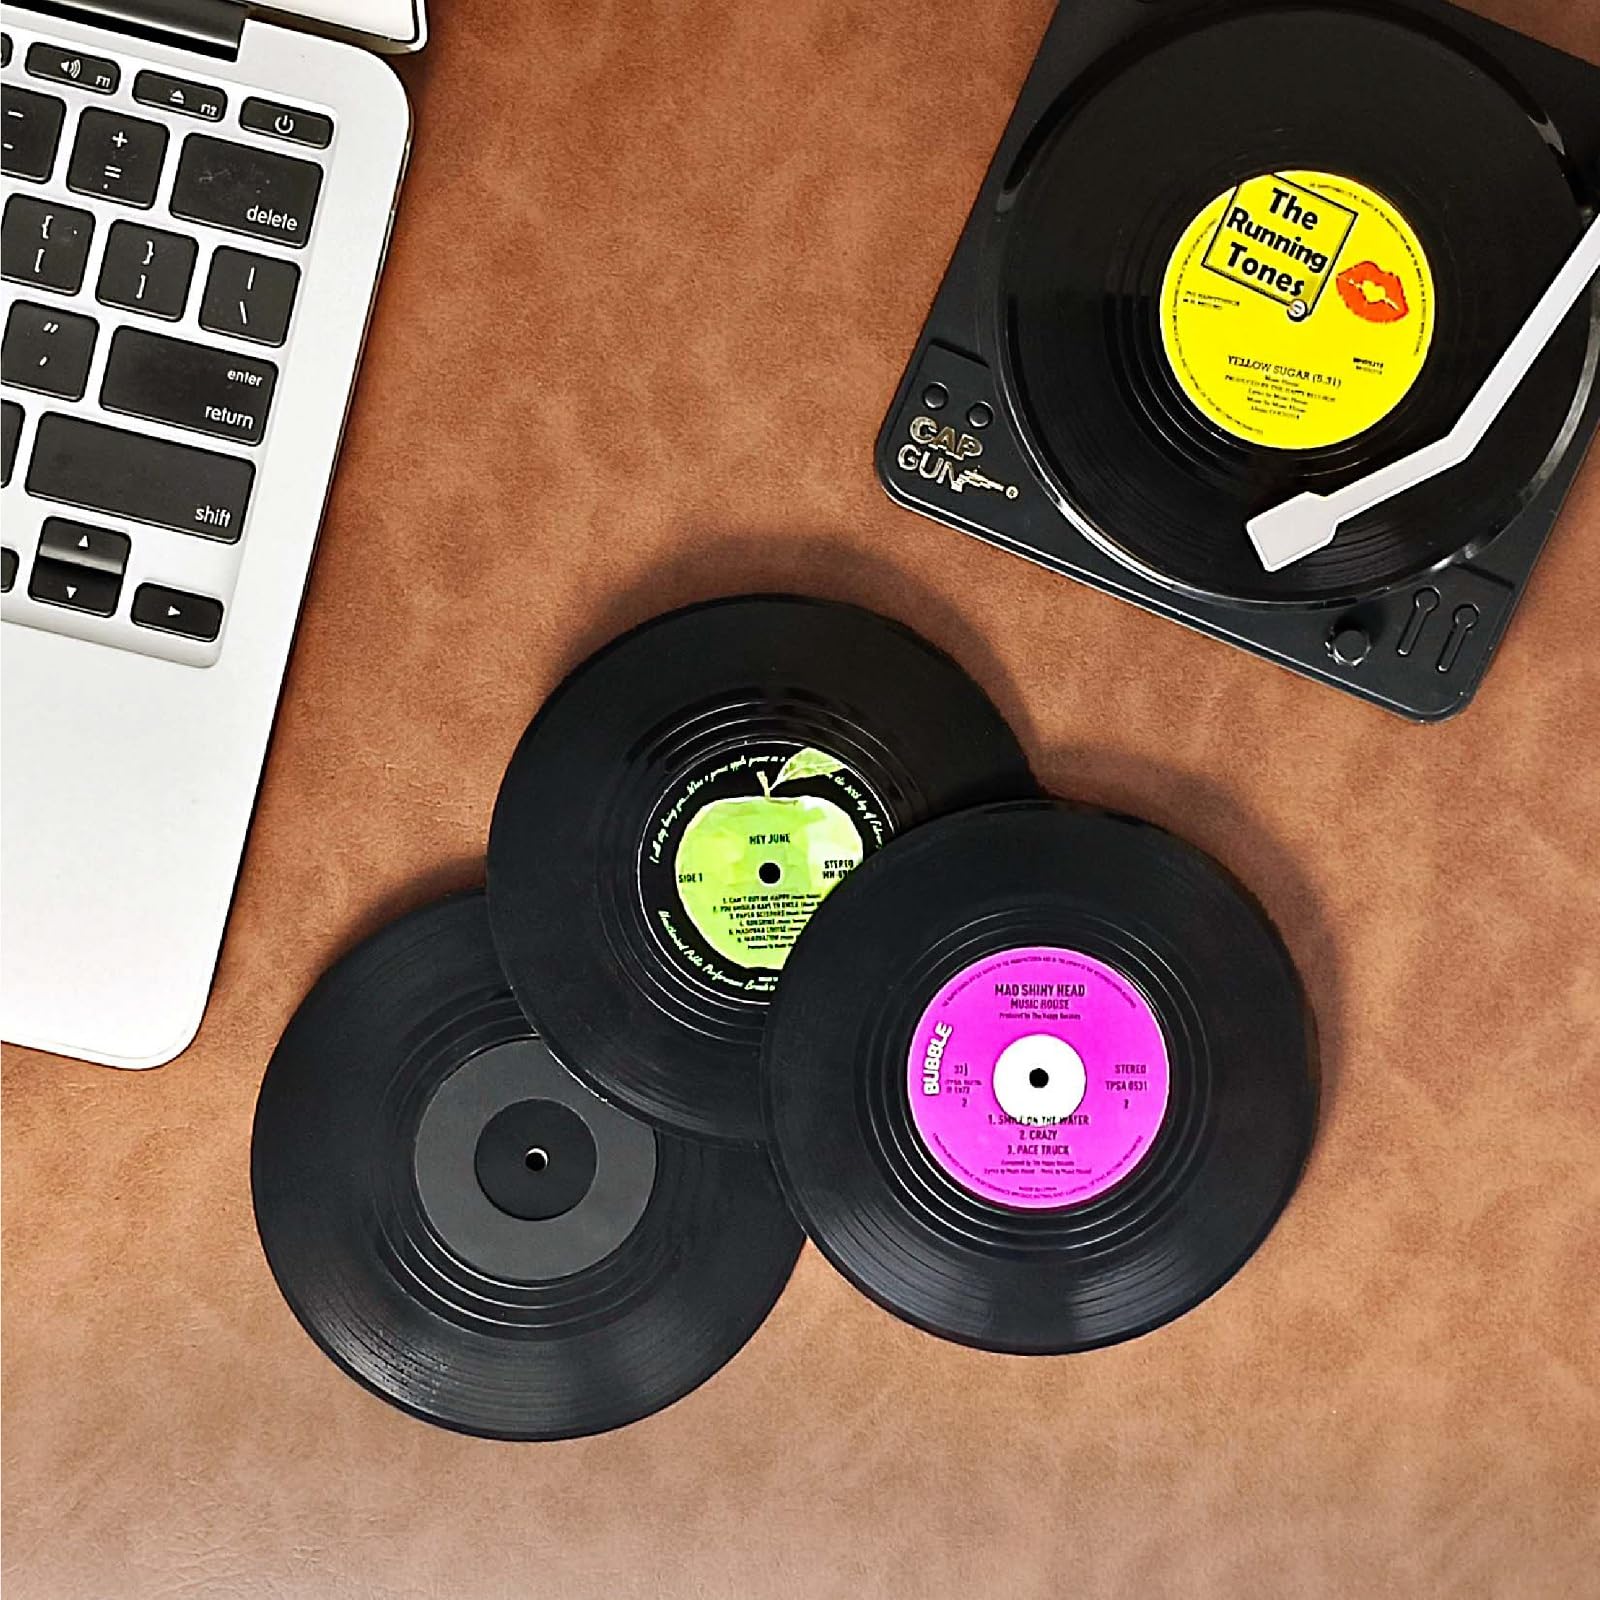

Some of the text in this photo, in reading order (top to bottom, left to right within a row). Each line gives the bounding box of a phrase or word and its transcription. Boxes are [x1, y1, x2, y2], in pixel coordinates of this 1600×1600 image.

[95, 75, 111, 88] F11
[200, 102, 218, 117] F12
[1269, 187, 1318, 230] The
[246, 205, 298, 232] delete
[1226, 206, 1328, 273] Running
[1228, 241, 1304, 296] Tones
[1228, 355, 1272, 372] YELLOW
[1273, 365, 1310, 381] SUGAR
[227, 368, 263, 388] enter
[205, 405, 254, 430] return
[909, 416, 984, 461] CAP
[897, 444, 963, 493] GUN
[195, 505, 232, 528] shift
[749, 833, 790, 845] HEY JUNE
[824, 859, 854, 869] STEREO
[678, 872, 703, 884] SIDE 1
[995, 983, 1085, 998] MAD SHINY HEAD
[1010, 998, 1069, 1010] MUSIC HOUSE
[922, 1021, 953, 1096] BUBBLE
[1114, 1064, 1147, 1074] STEREO
[1059, 1114, 1090, 1126] WATER
[1029, 1129, 1058, 1141] CRAZY
[1041, 1145, 1069, 1156] TRUCK
